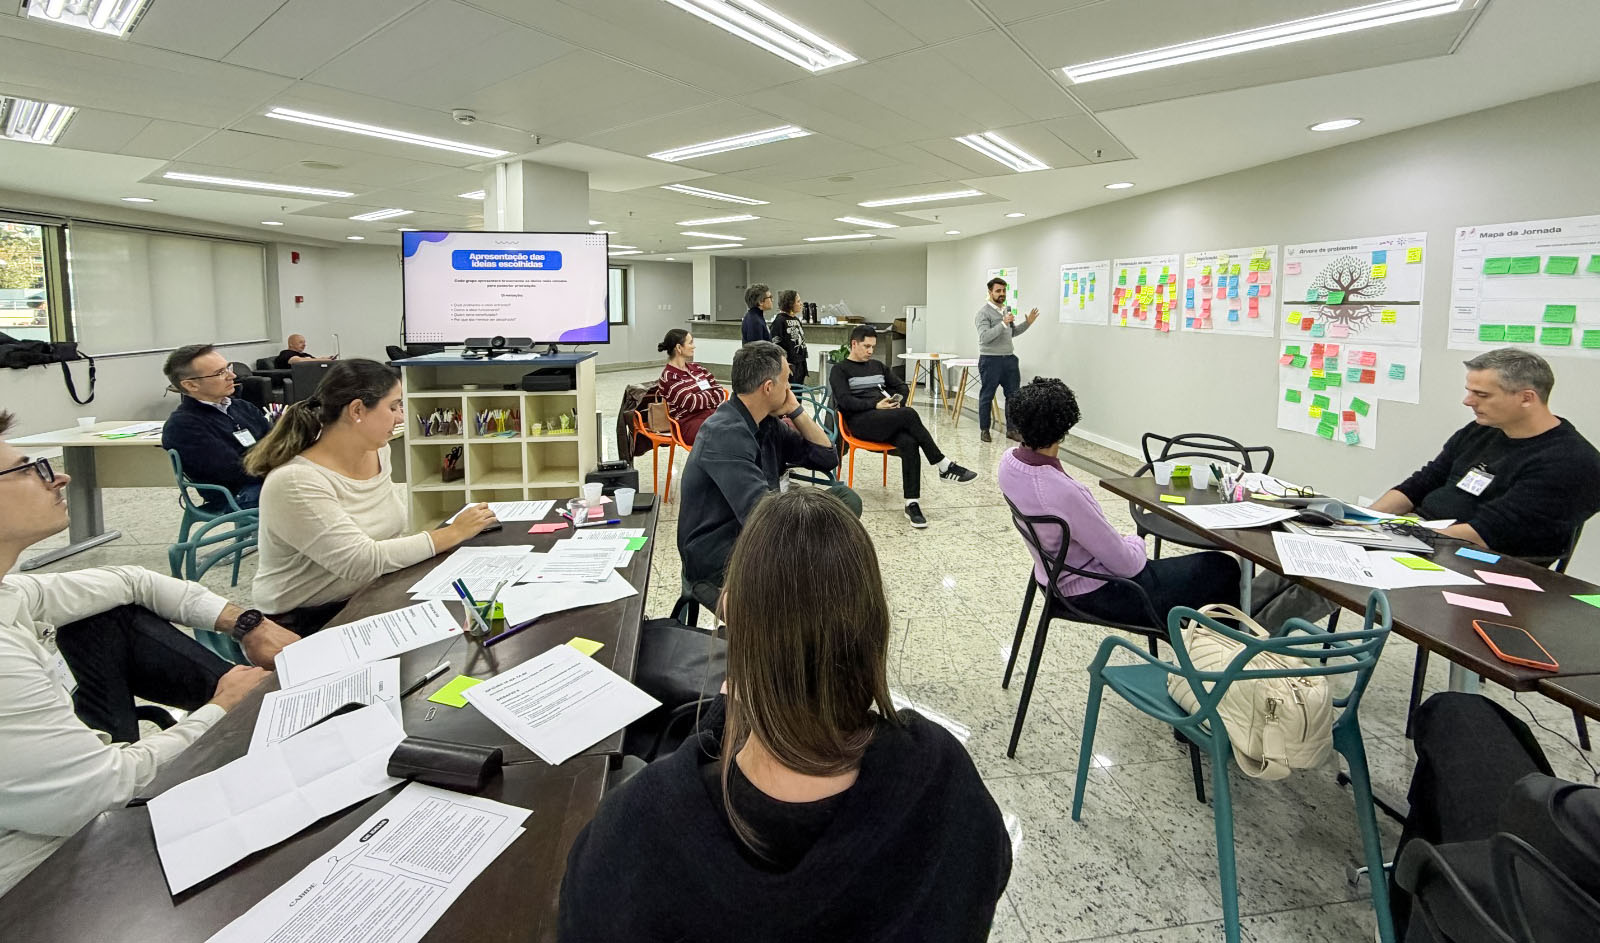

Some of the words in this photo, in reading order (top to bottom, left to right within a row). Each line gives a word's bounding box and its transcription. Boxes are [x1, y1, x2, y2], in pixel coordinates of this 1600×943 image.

[1520, 227, 1562, 236] Jornada
[469, 252, 529, 261] Apresentação
[529, 253, 546, 261] das
[498, 260, 544, 268] escolhidas
[289, 882, 318, 907] CABIDE
